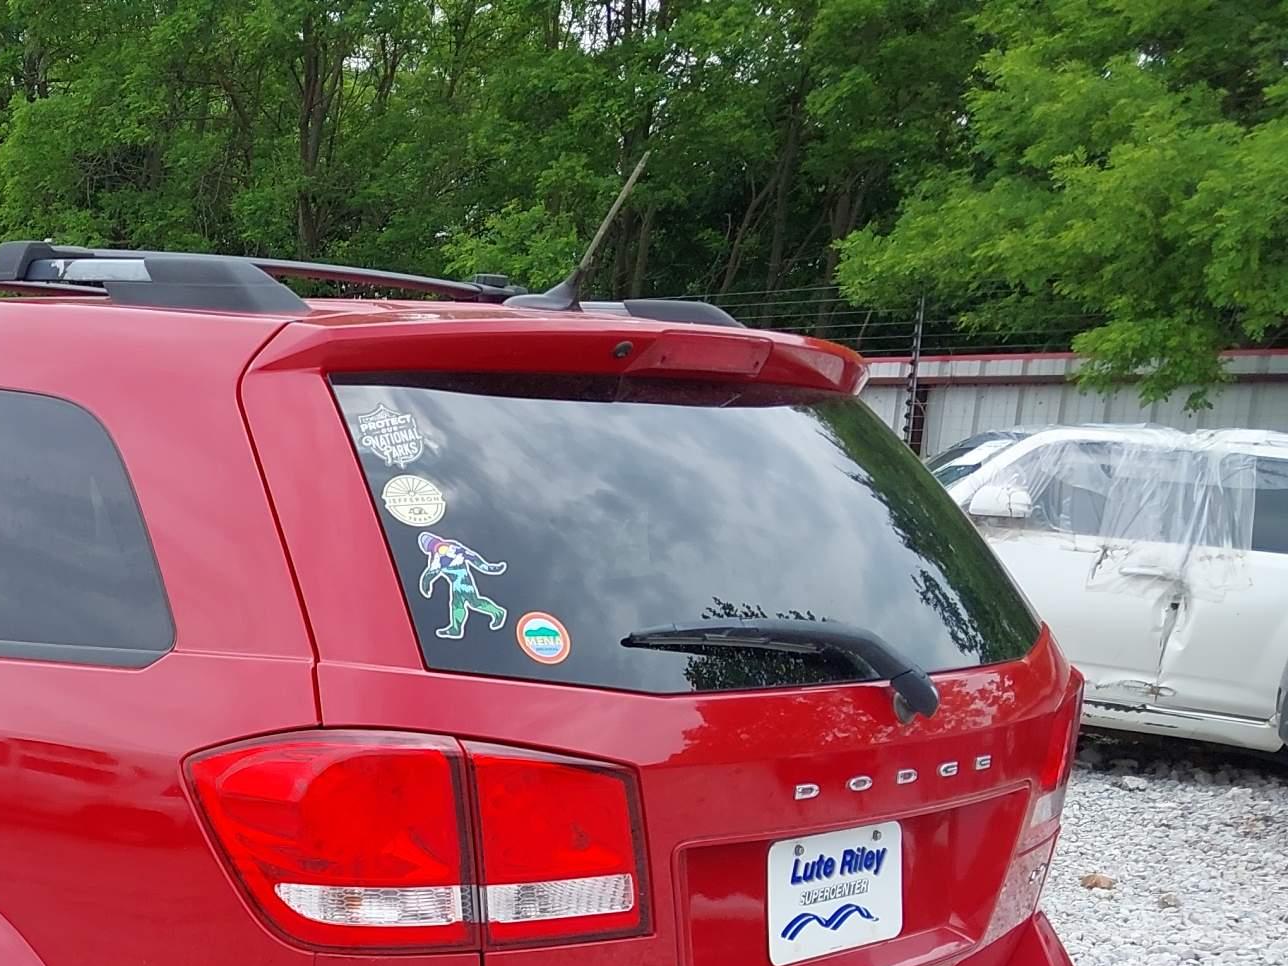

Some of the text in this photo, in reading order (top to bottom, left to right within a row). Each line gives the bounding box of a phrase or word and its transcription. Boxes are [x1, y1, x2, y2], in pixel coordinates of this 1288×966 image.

[360, 414, 412, 433] PROTECT
[362, 428, 423, 452] NATIONAL
[383, 442, 419, 465] PARKS
[388, 496, 440, 505] JEFFERSON
[794, 754, 992, 801] DODGE
[790, 846, 887, 885] Lute Riley
[799, 878, 870, 906] SUPERCENTER
